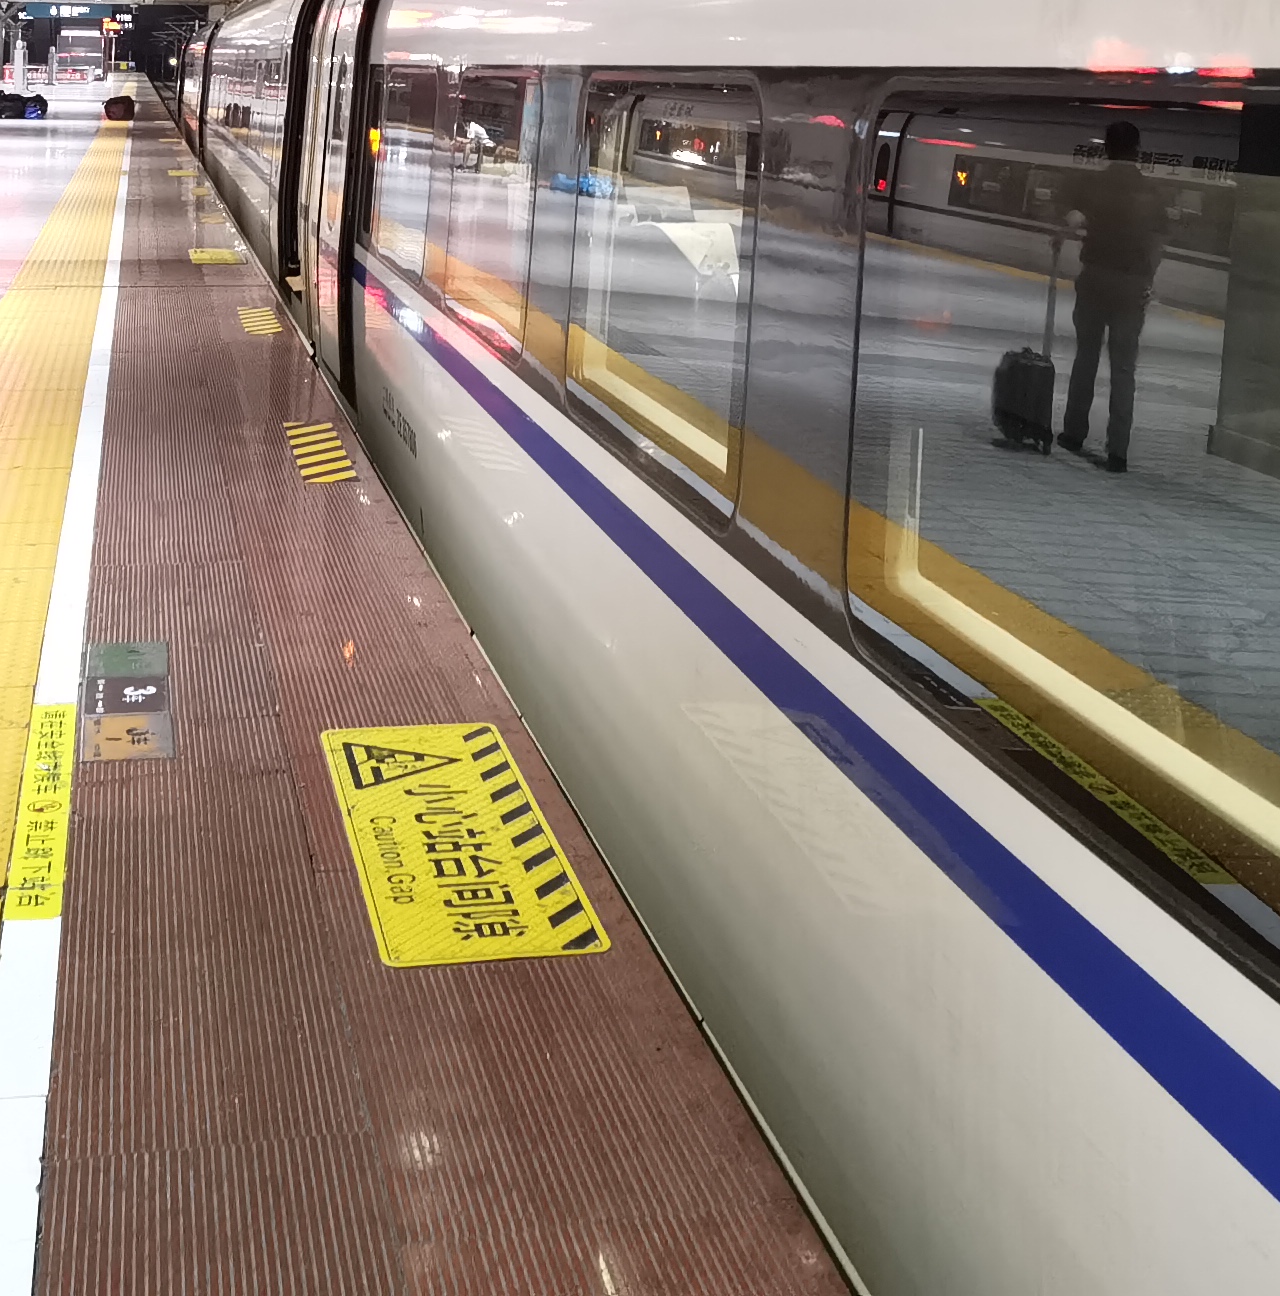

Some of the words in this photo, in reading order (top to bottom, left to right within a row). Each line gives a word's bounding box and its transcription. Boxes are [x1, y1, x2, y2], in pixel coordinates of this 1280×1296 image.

[15, 819, 59, 909] 禁止跳下站台
[403, 783, 529, 941] 小心站台间隙
